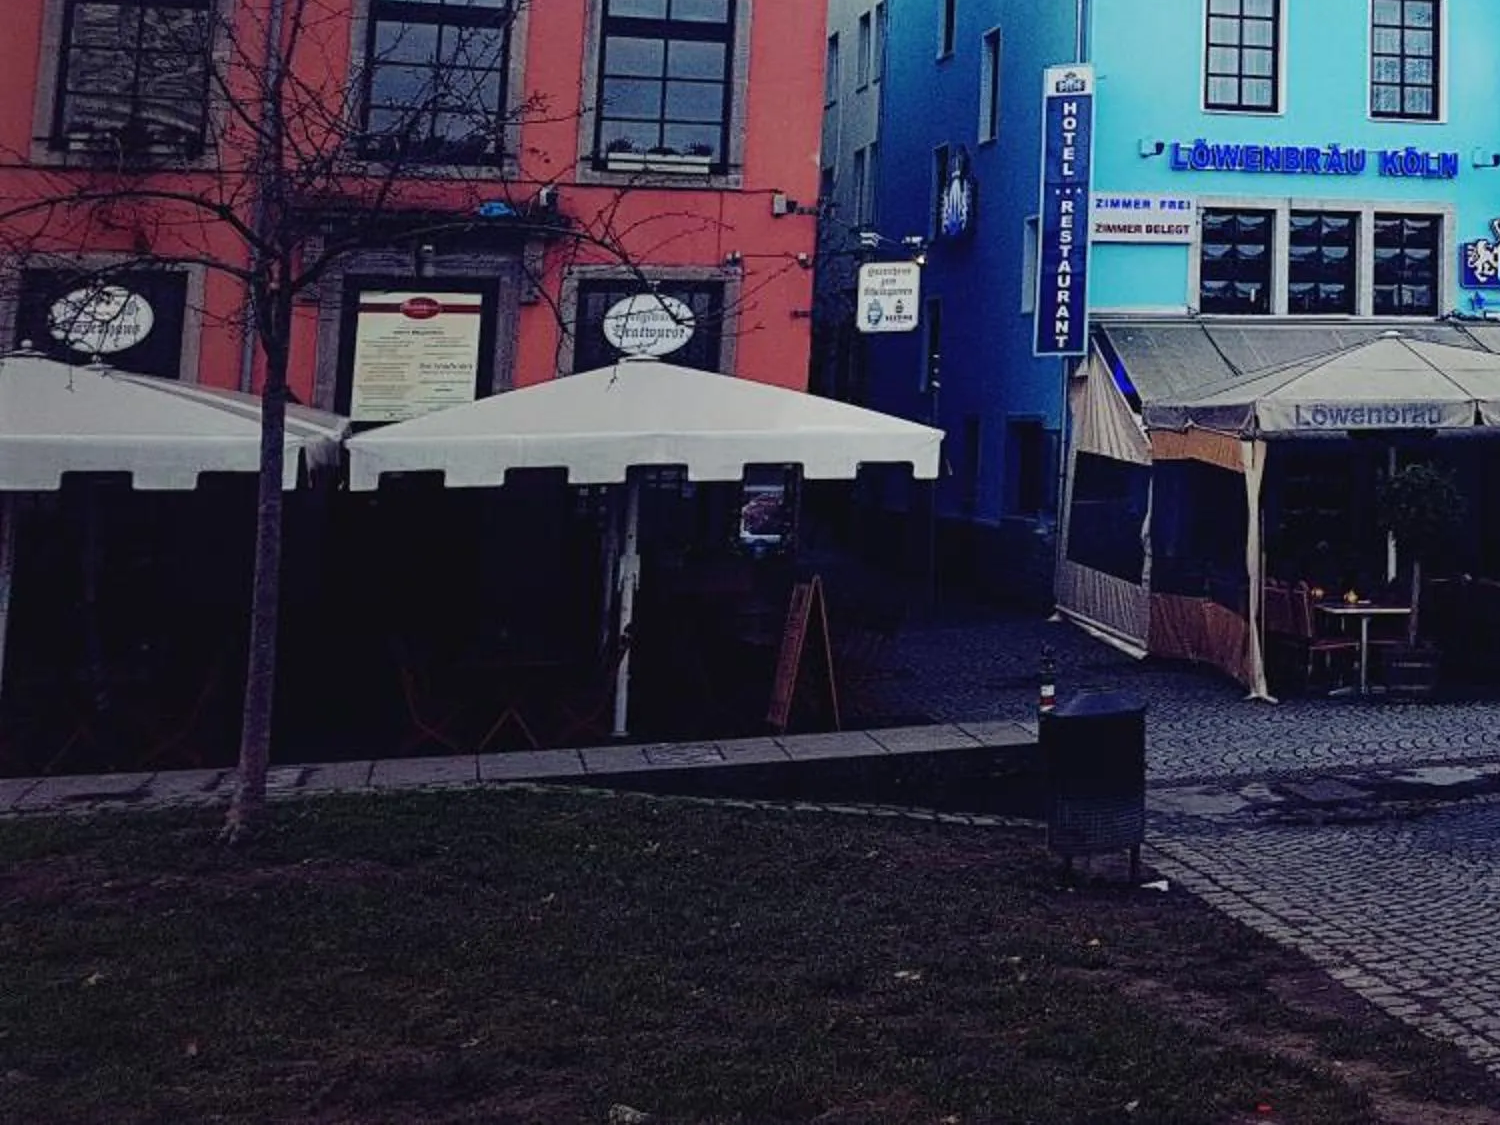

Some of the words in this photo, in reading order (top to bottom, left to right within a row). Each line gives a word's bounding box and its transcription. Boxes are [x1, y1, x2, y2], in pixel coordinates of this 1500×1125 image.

[1063, 102, 1077, 176] HOTEL
[1170, 139, 1366, 175] LÖWENBRÄU
[1378, 146, 1459, 179] KÖLN
[1095, 198, 1151, 209] ZIMMER
[1160, 200, 1191, 210] FREI
[1095, 223, 1142, 234] ZIMMER
[1055, 200, 1074, 348] RESTAURANT
